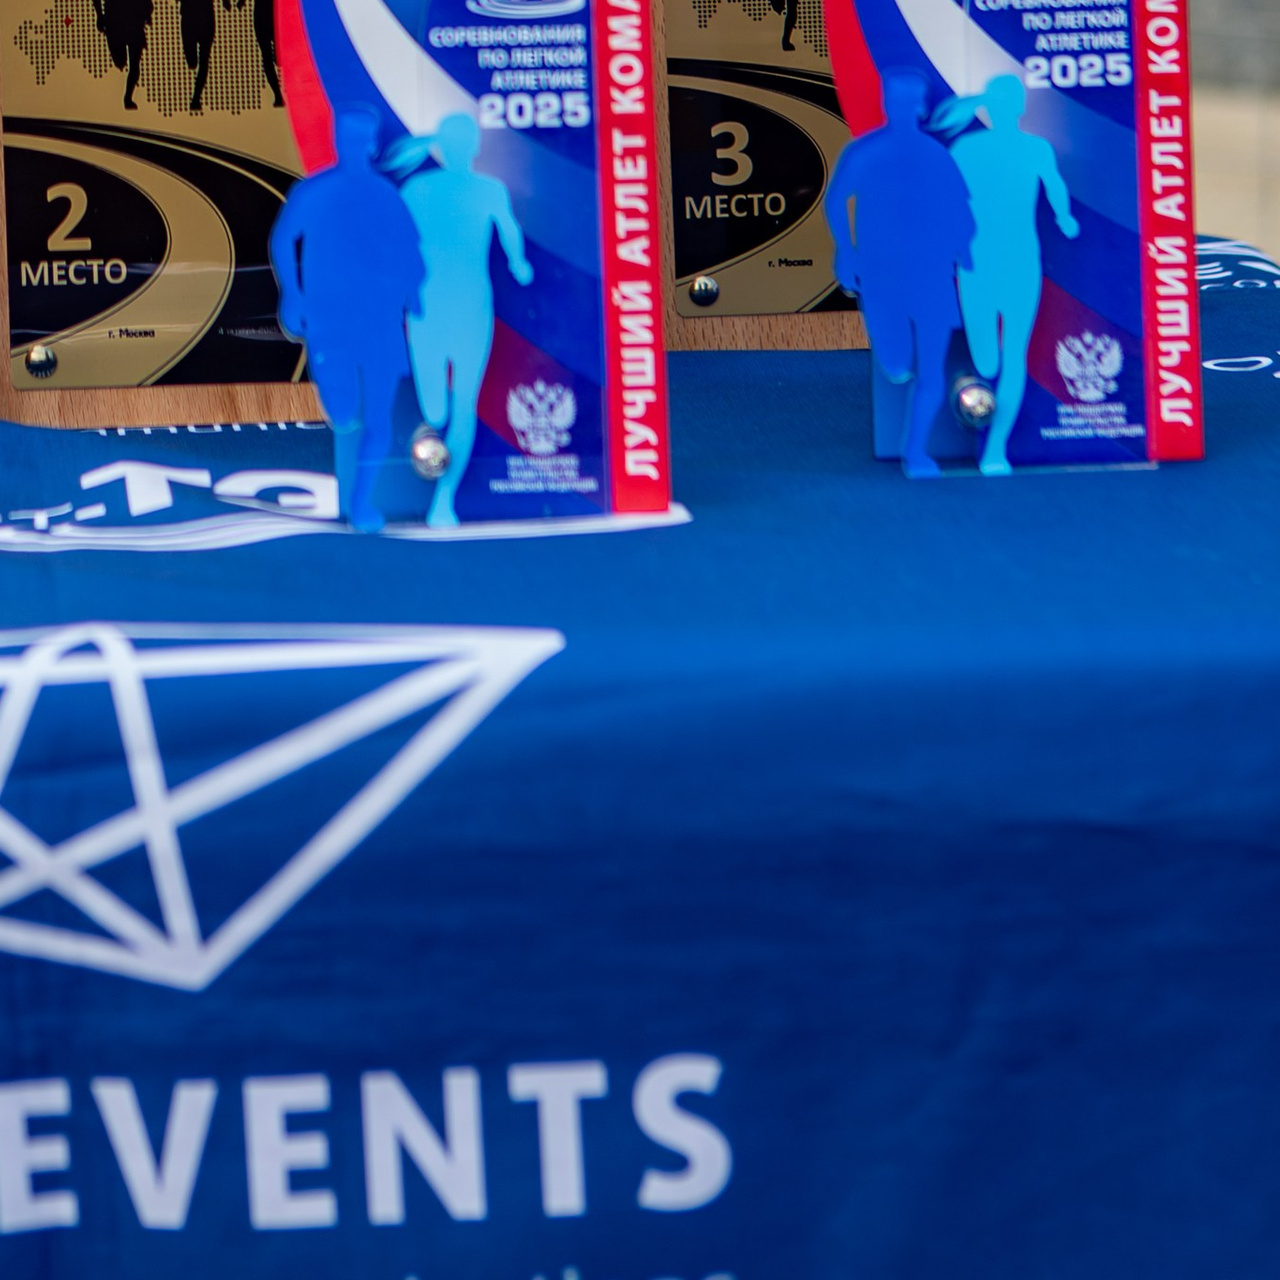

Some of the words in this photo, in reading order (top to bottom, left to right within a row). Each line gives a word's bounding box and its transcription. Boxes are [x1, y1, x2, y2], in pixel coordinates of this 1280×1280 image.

[1024, 53, 1133, 89] 2025
[478, 91, 591, 129] 2025
[710, 121, 753, 186] 3
[1149, 88, 1186, 221] АТЛЕТ
[46, 182, 92, 252] 2
[614, 130, 651, 263] АТЛЕТ
[684, 193, 786, 219] МЕСТО
[20, 258, 128, 287] МЕСТО
[1148, 236, 1194, 428] ЛУЧШИЙ
[613, 279, 660, 481] ЛУЧШИЙ
